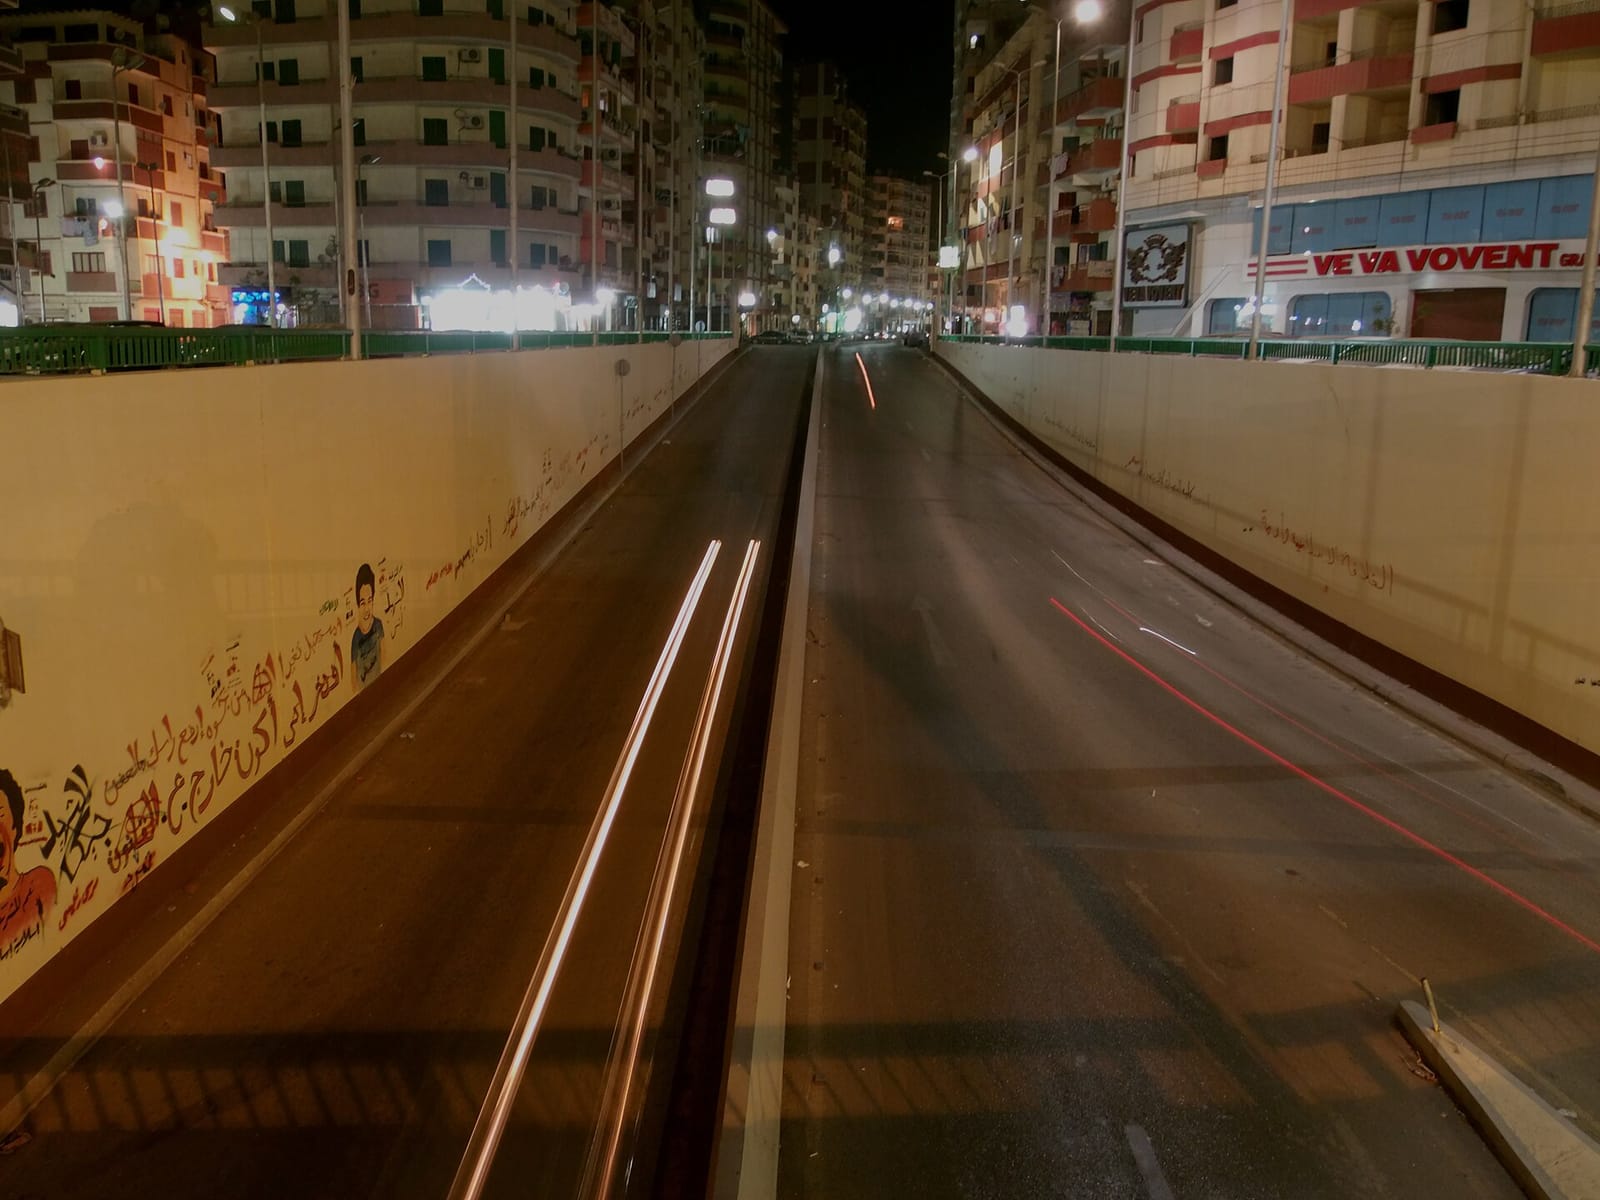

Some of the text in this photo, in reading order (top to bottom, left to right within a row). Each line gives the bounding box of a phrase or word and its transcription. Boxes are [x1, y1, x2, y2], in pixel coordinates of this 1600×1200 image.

[1313, 253, 1353, 276] VE
[1359, 249, 1400, 274] VA
[1406, 243, 1560, 271] VOVENT
